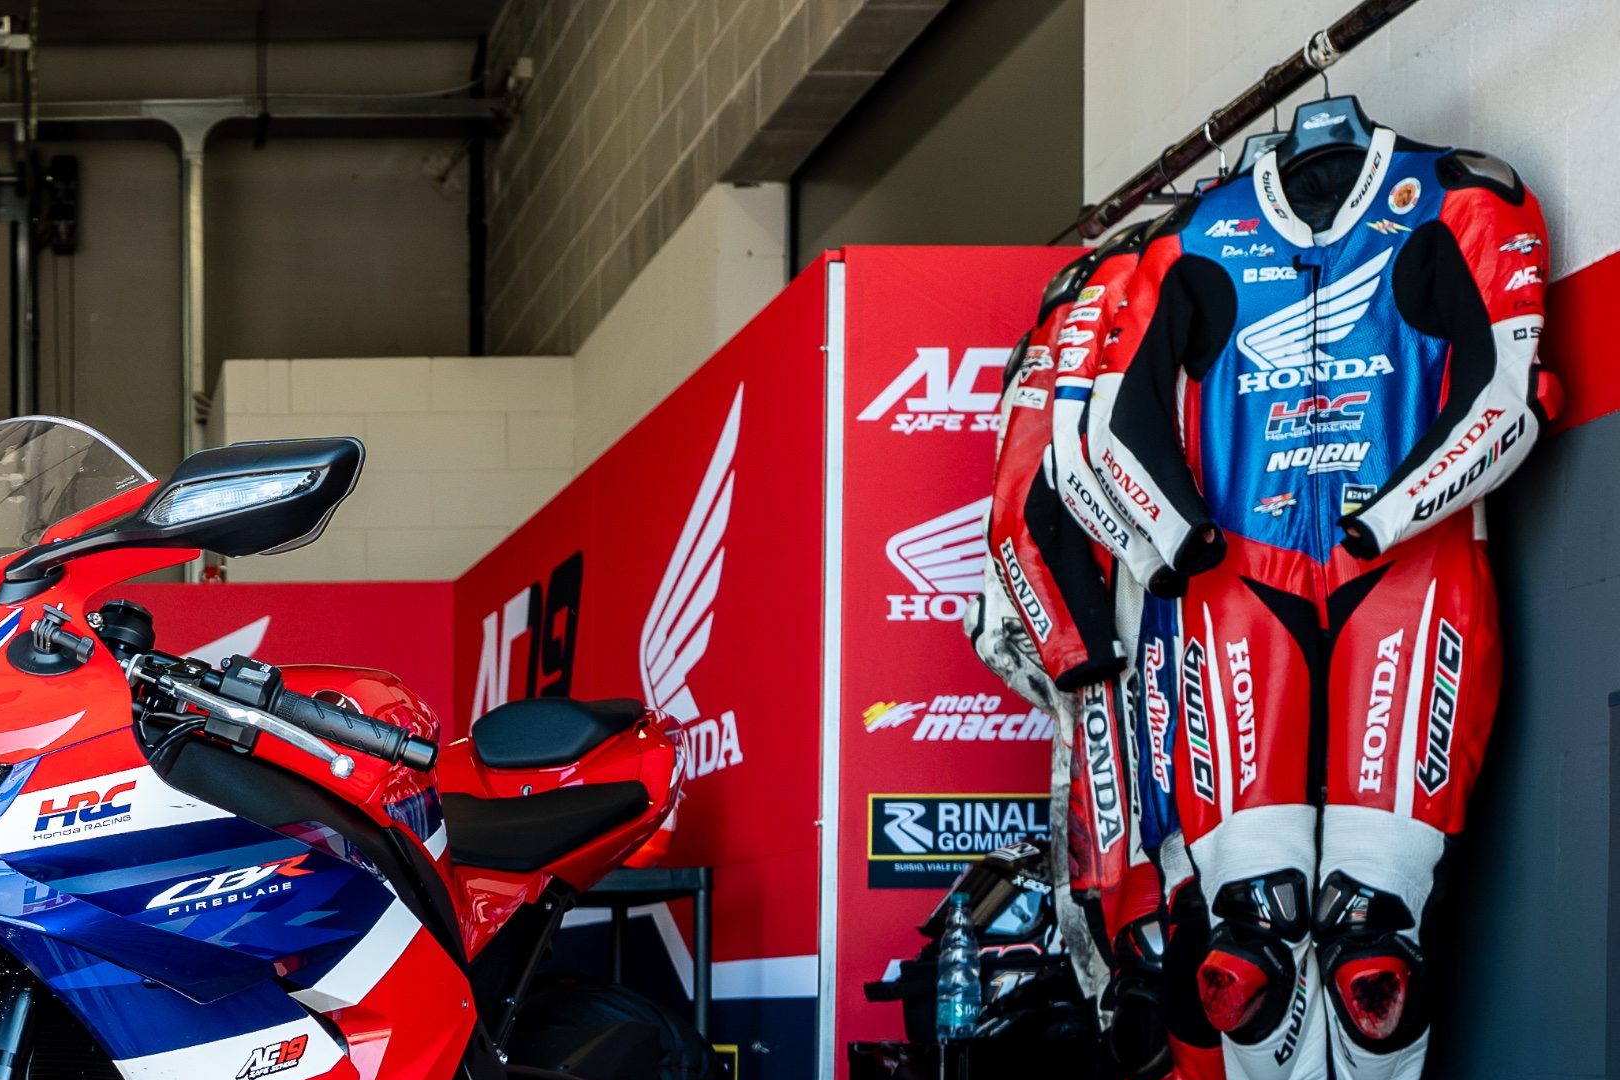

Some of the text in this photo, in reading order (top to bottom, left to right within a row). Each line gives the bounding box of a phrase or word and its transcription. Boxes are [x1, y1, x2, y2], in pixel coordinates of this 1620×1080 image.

[857, 347, 1014, 421] AC
[1238, 354, 1394, 395] HONDA
[891, 413, 964, 434] SAFE
[1265, 391, 1371, 434] HRC
[1312, 422, 1362, 434] RACING
[1266, 441, 1371, 476] NOLAN
[1406, 407, 1506, 498] HONDA
[1102, 447, 1161, 522] HONDA
[1067, 471, 1130, 550] HONDA
[1002, 541, 1051, 640] HONDA
[929, 693, 1001, 712] moto
[1146, 637, 1172, 793] RedMoto
[1226, 638, 1257, 796] HONDA
[1358, 629, 1403, 793] HONDA
[683, 711, 744, 781] NDA
[1084, 680, 1122, 852] HONDA
[33, 814, 132, 841] Honda RACING
[34, 781, 137, 832] HRC
[938, 802, 1052, 832] RINAL
[927, 863, 951, 872] VIALE
[168, 881, 292, 916] FIREBLADE
[236, 1034, 308, 1080] AC19
